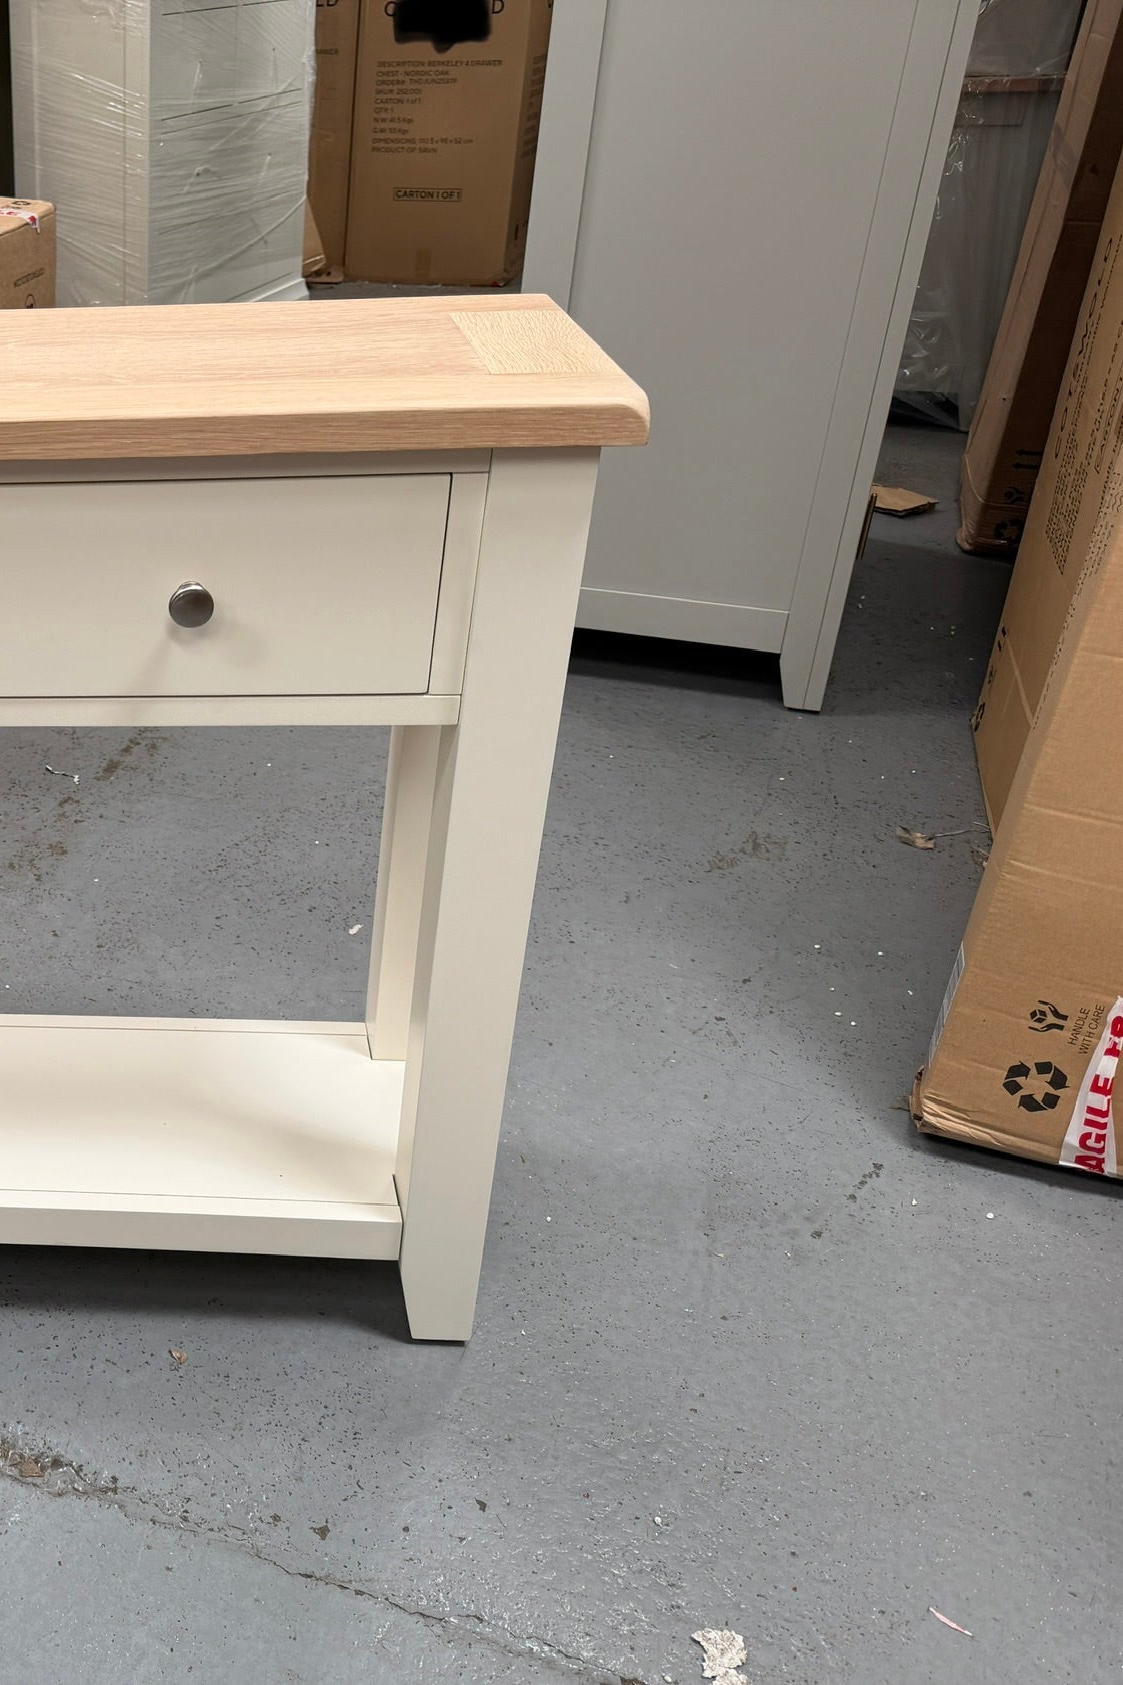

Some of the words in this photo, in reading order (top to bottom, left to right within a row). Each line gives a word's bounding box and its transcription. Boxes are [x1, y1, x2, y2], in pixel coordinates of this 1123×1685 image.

[395, 189, 434, 199] CARTON
[441, 190, 456, 200] OF
[1067, 1006, 1090, 1046] HANDLE
[1077, 1030, 1095, 1056] WITH
[1087, 1002, 1105, 1030] CARE
